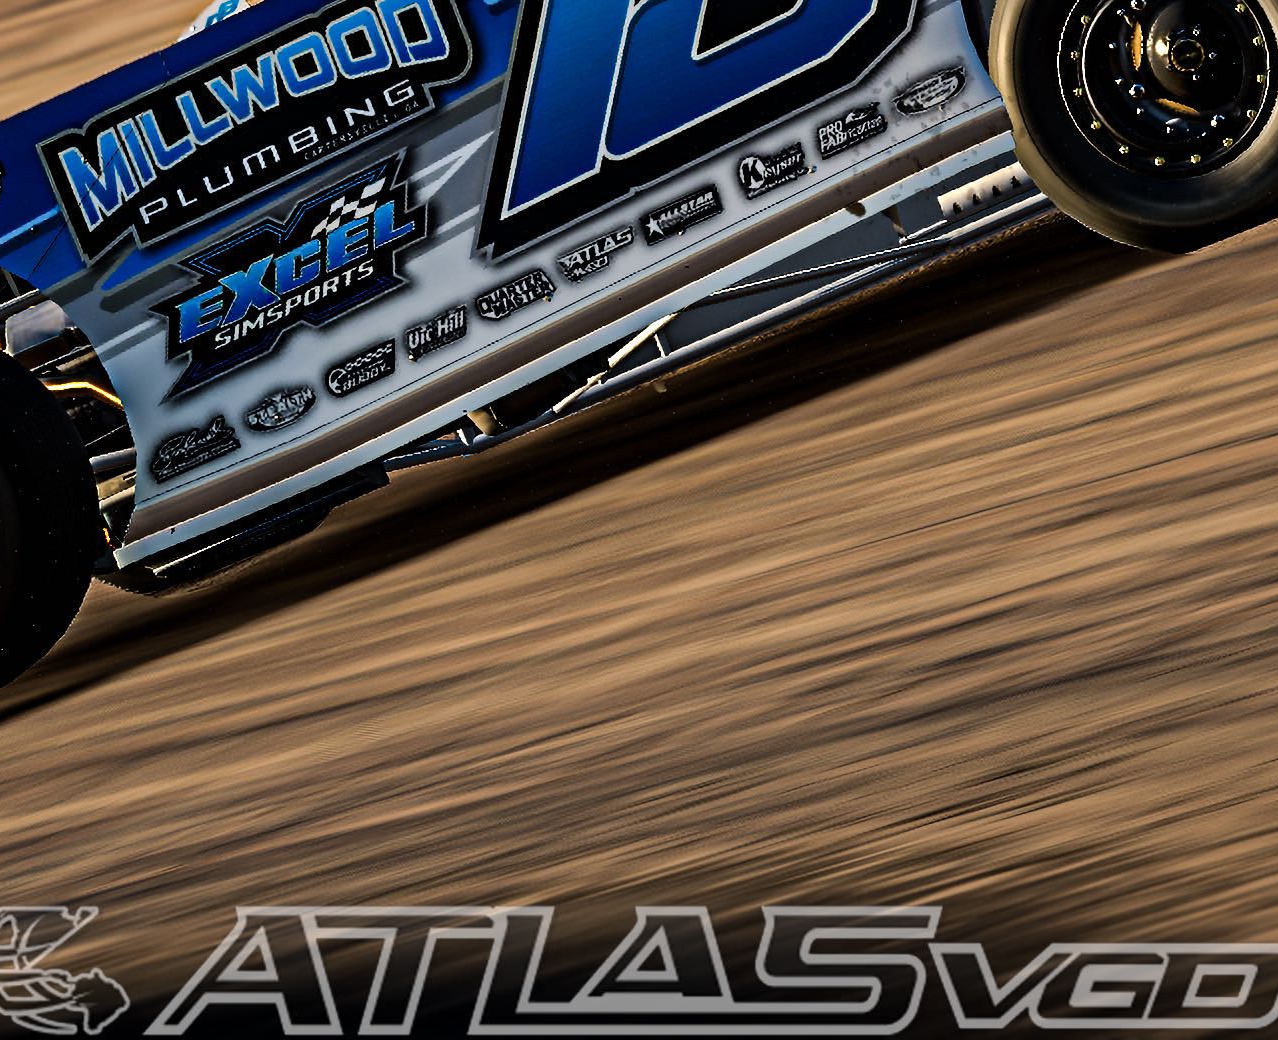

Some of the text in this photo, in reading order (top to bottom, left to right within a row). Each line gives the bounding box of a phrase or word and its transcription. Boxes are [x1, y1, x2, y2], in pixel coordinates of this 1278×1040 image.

[138, 78, 415, 224] PLUMBING
[819, 120, 843, 140] PRO
[175, 200, 416, 344] EXCEL
[214, 259, 374, 349] SIMSPORTS
